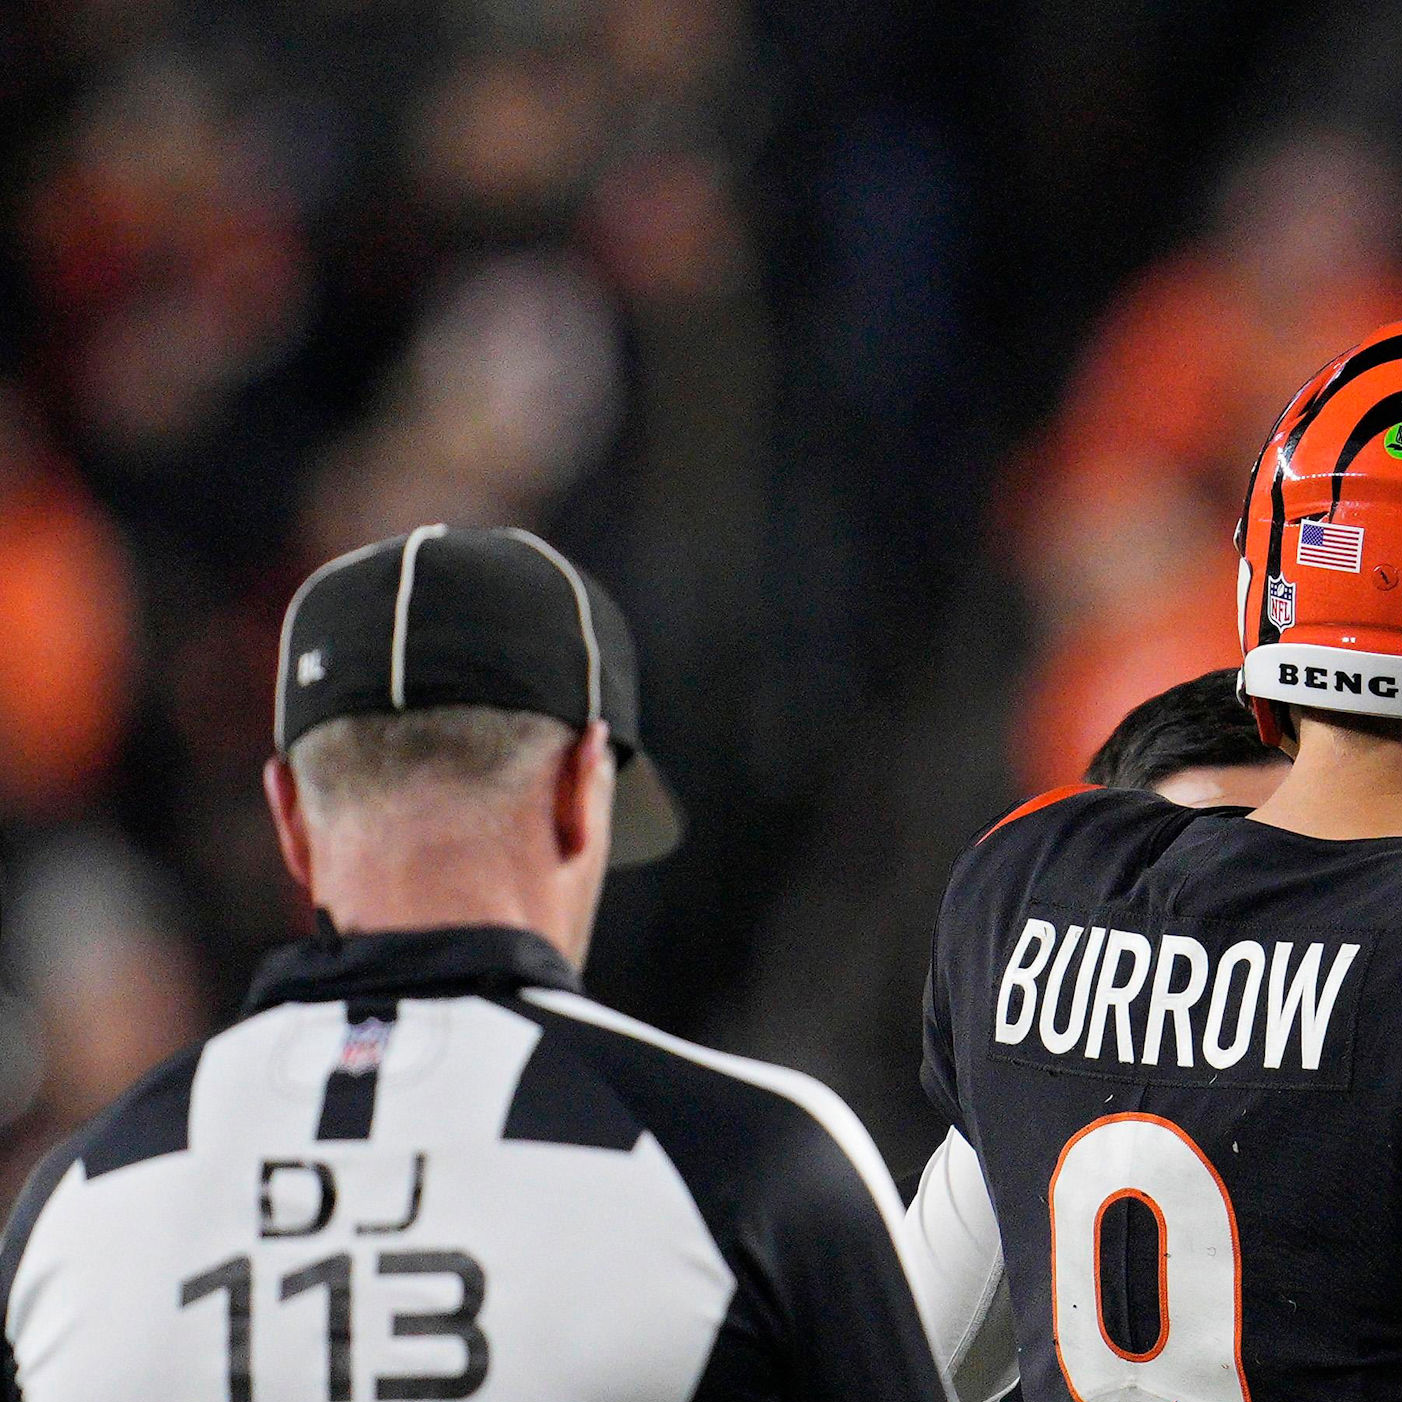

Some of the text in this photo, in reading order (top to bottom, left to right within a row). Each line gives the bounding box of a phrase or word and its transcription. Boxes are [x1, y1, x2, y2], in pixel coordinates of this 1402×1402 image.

[1271, 598, 1291, 622] NFL
[994, 918, 1360, 1071] BURROW
[259, 1151, 427, 1238] DJ
